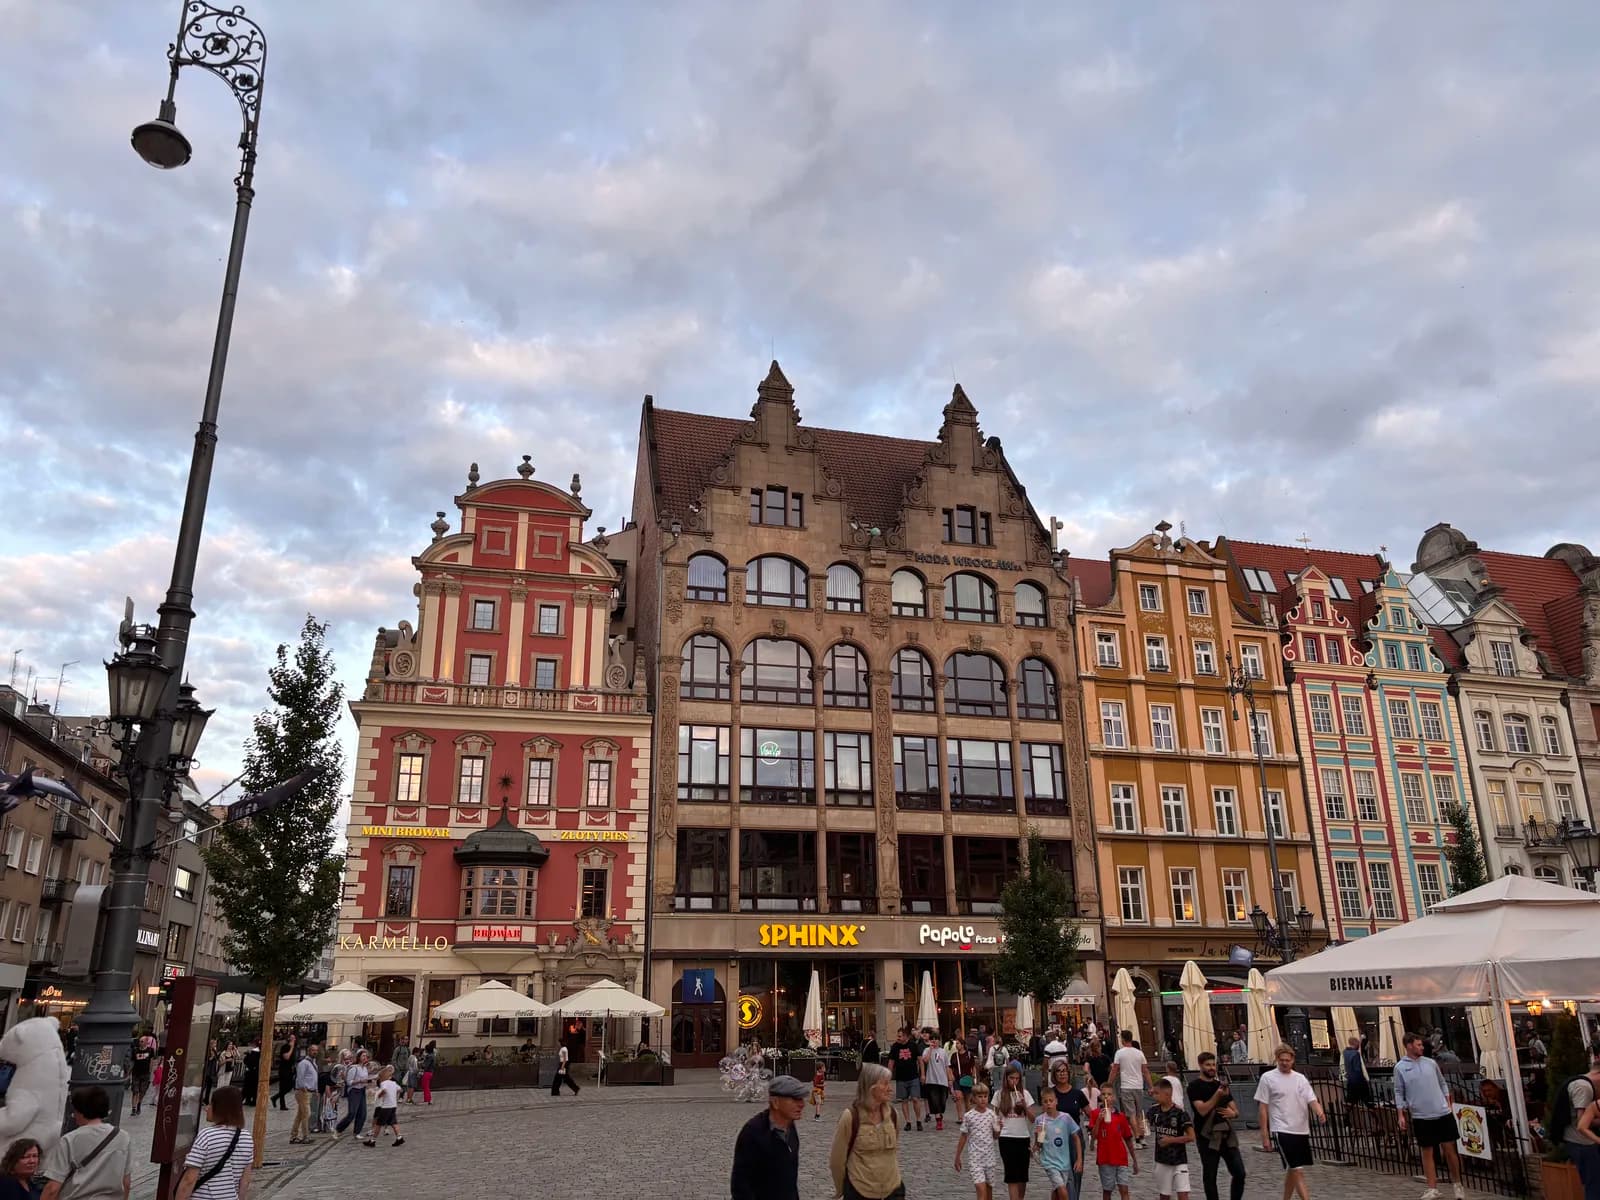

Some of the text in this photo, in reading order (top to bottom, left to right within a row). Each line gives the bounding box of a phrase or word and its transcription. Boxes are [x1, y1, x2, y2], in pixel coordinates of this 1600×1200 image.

[362, 825, 450, 838] MINI BROWAR
[602, 832, 629, 841] PIES
[473, 928, 521, 938] BROWAR
[759, 924, 860, 946] SPHINX
[340, 935, 449, 950] KARMELLO
[1329, 975, 1393, 991] BIERHALLE
